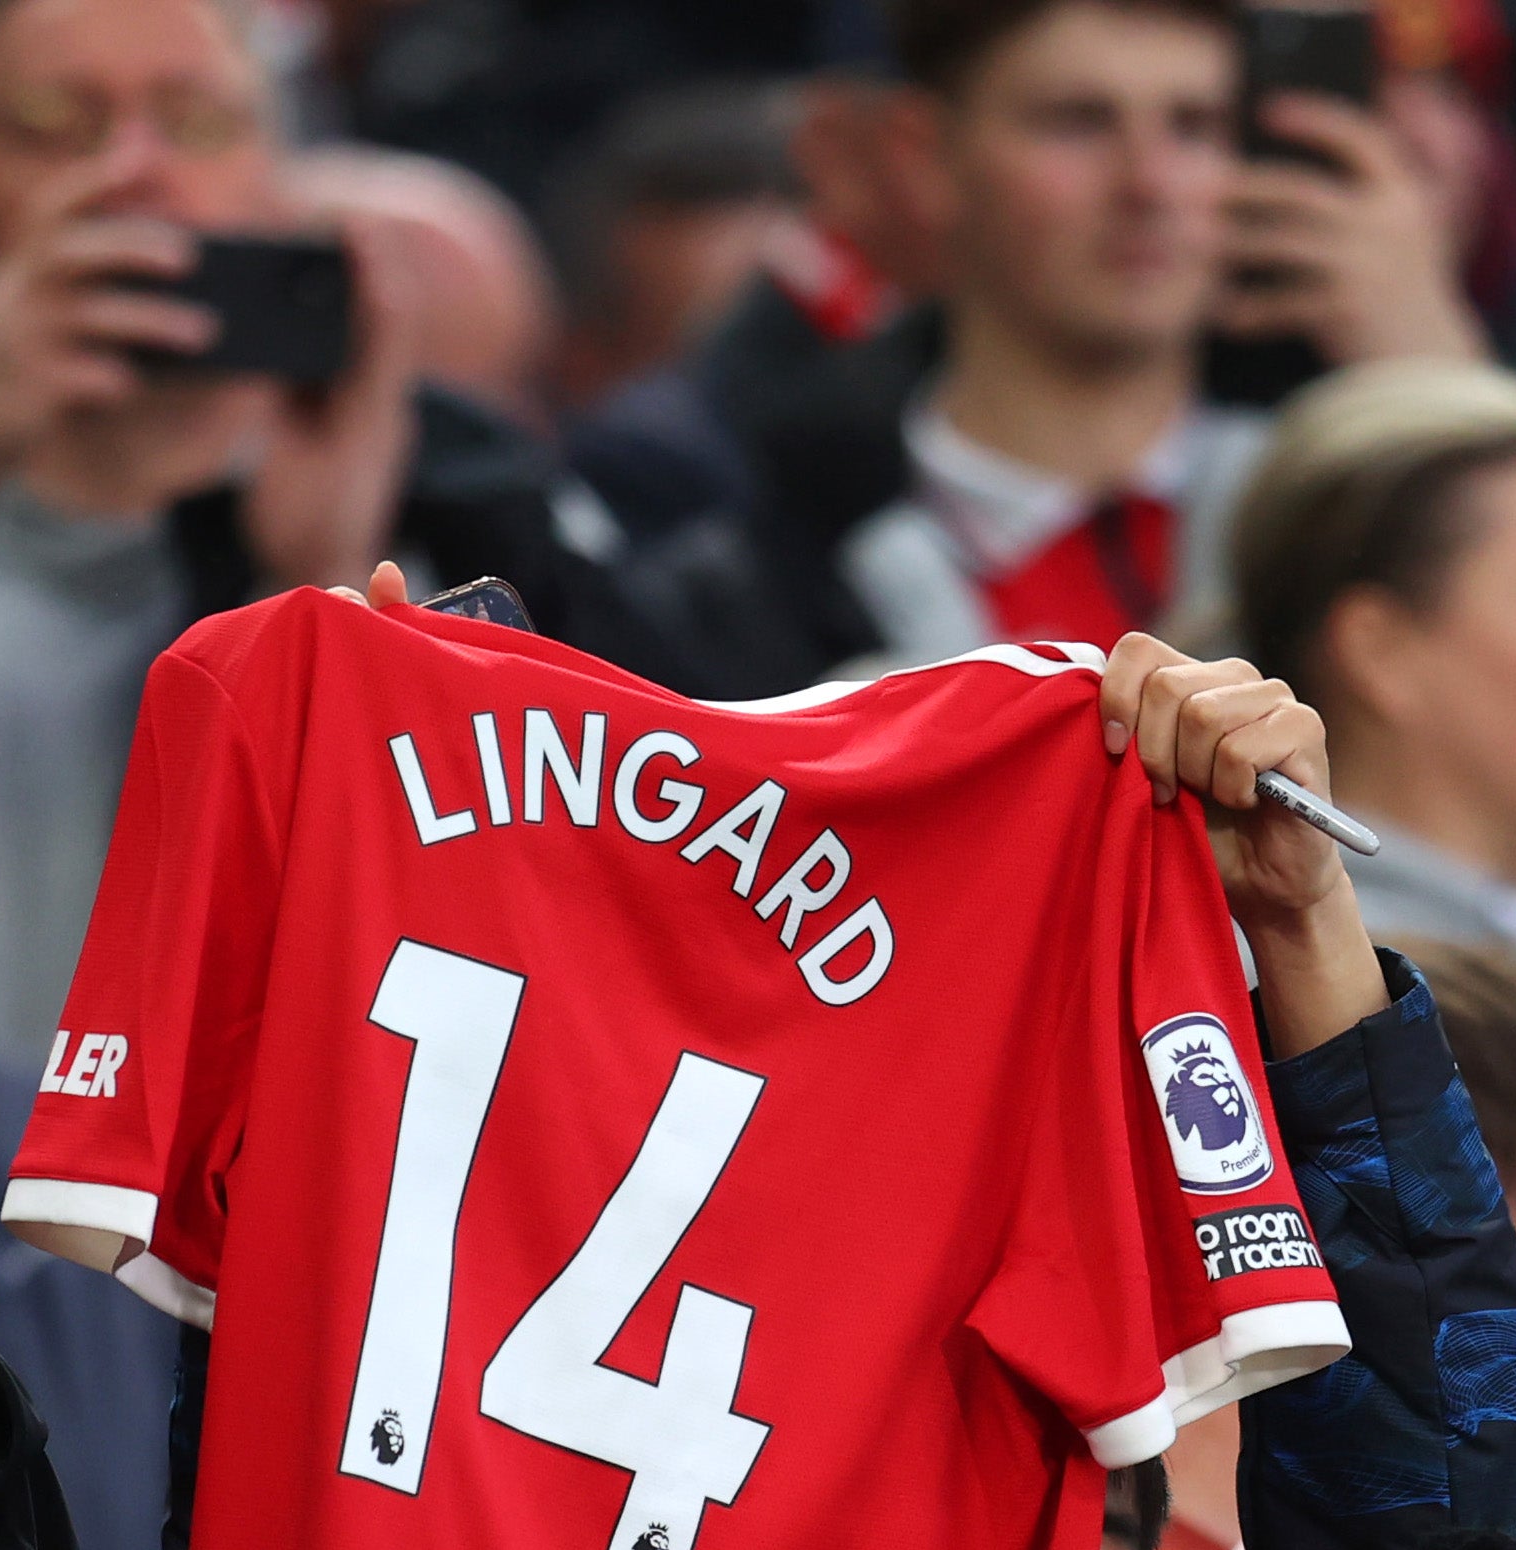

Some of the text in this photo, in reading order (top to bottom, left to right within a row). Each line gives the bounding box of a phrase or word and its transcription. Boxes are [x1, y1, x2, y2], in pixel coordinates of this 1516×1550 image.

[388, 708, 895, 1006] LINGARD
[38, 1029, 128, 1098] LER
[1225, 1211, 1307, 1244] room
[1228, 1240, 1324, 1274] racism
